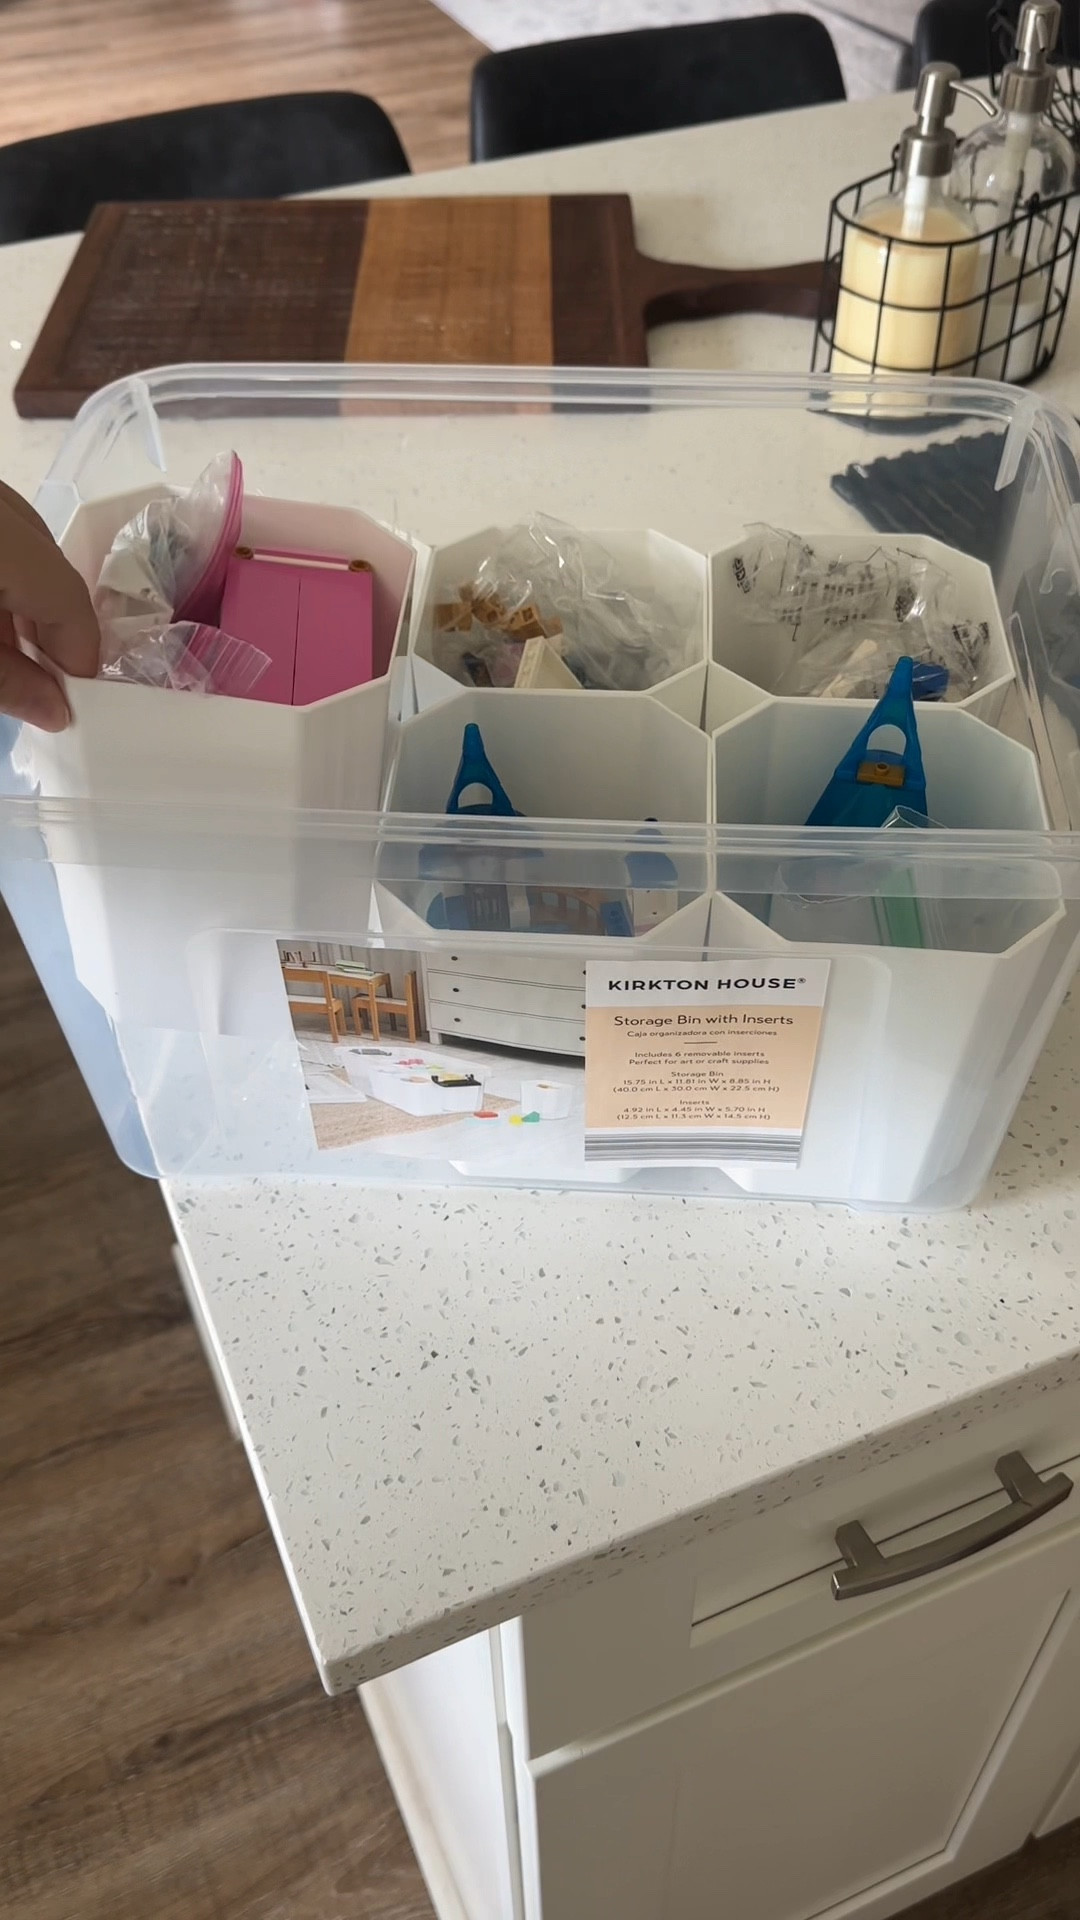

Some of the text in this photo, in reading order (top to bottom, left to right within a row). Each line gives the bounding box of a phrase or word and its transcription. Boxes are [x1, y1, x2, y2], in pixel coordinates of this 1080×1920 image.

[608, 979, 709, 991] KIRKTON
[613, 1013, 794, 1028] Storage Bin with Inserts
[626, 1030, 647, 1038] Caja
